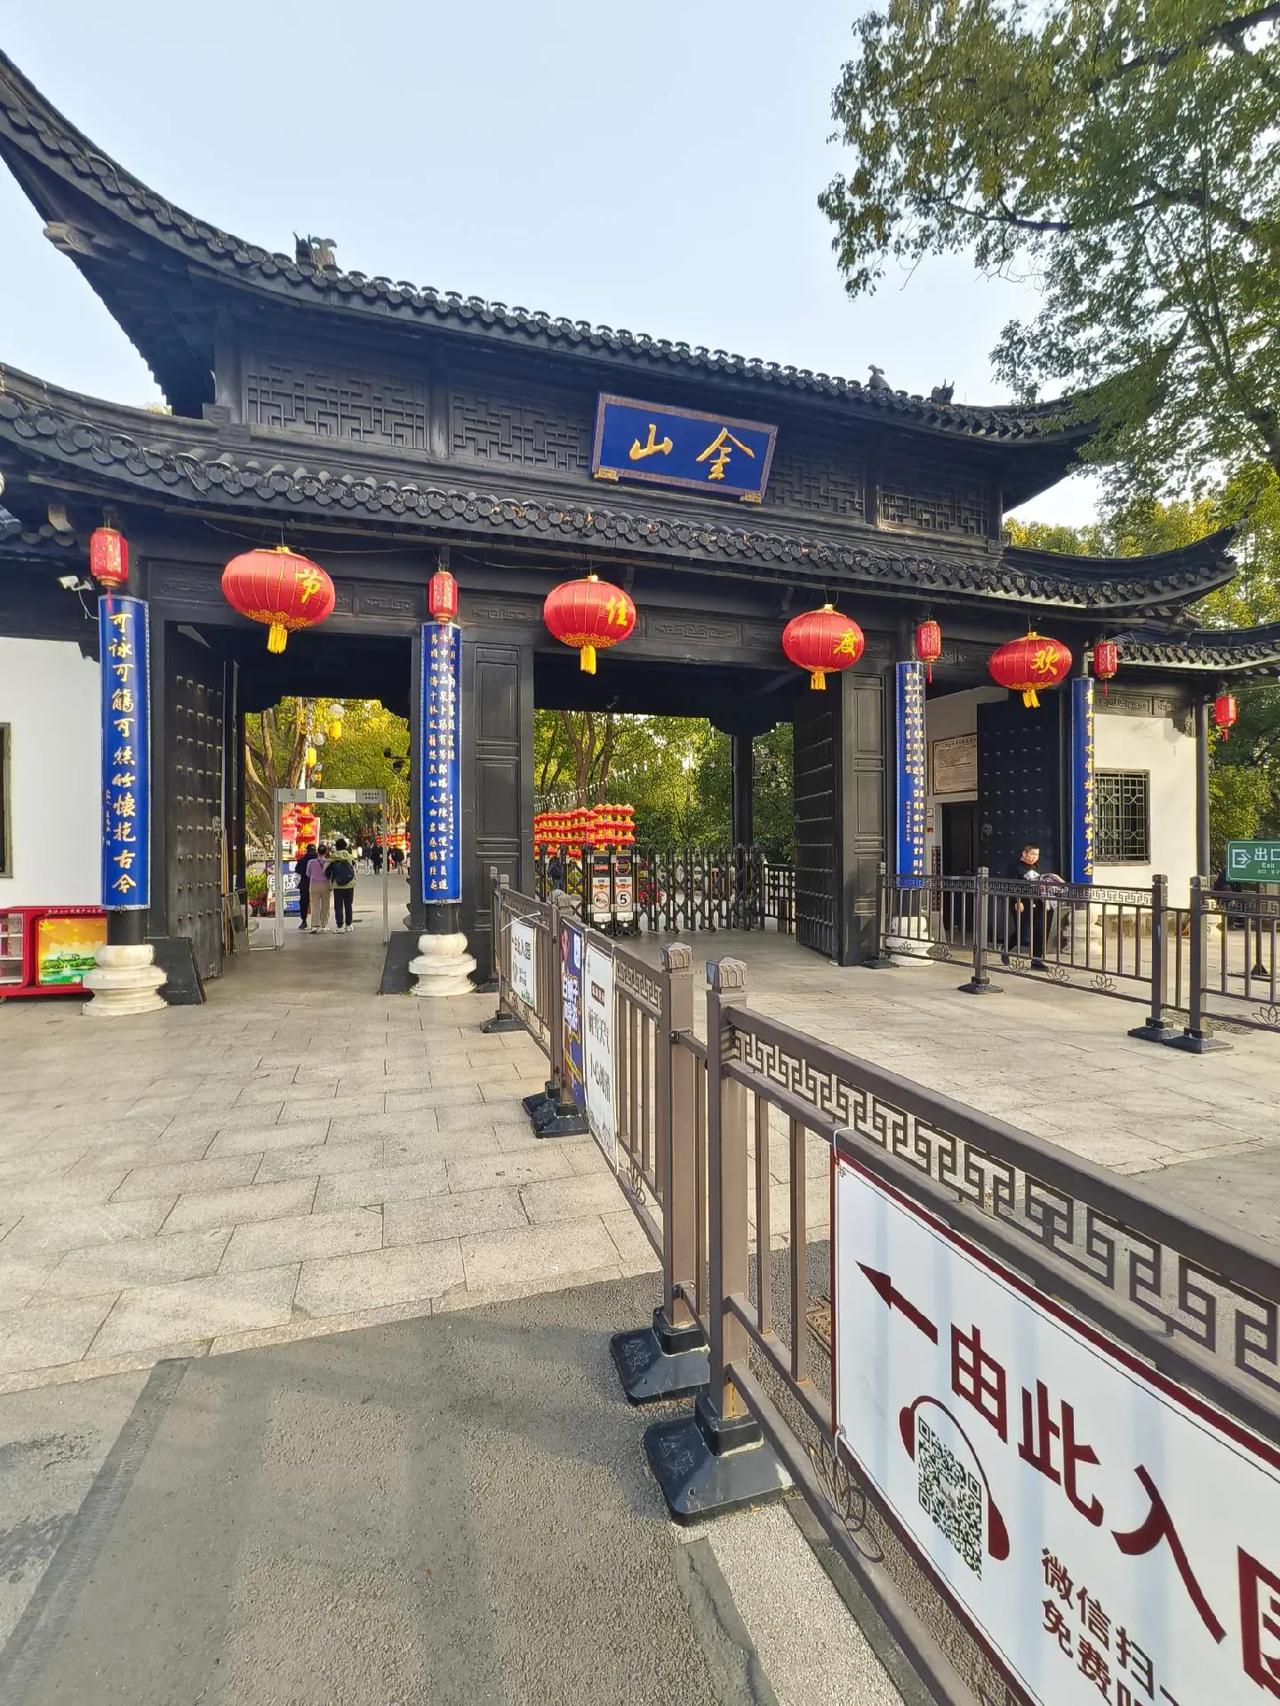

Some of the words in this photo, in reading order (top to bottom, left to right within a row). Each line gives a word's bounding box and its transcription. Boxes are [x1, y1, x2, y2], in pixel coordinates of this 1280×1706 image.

[293, 568, 325, 604] 节
[607, 595, 628, 627] 佳
[832, 626, 858, 658] 度
[1029, 645, 1060, 676] 欢
[1254, 847, 1280, 861] 出口
[619, 894, 628, 905] 5
